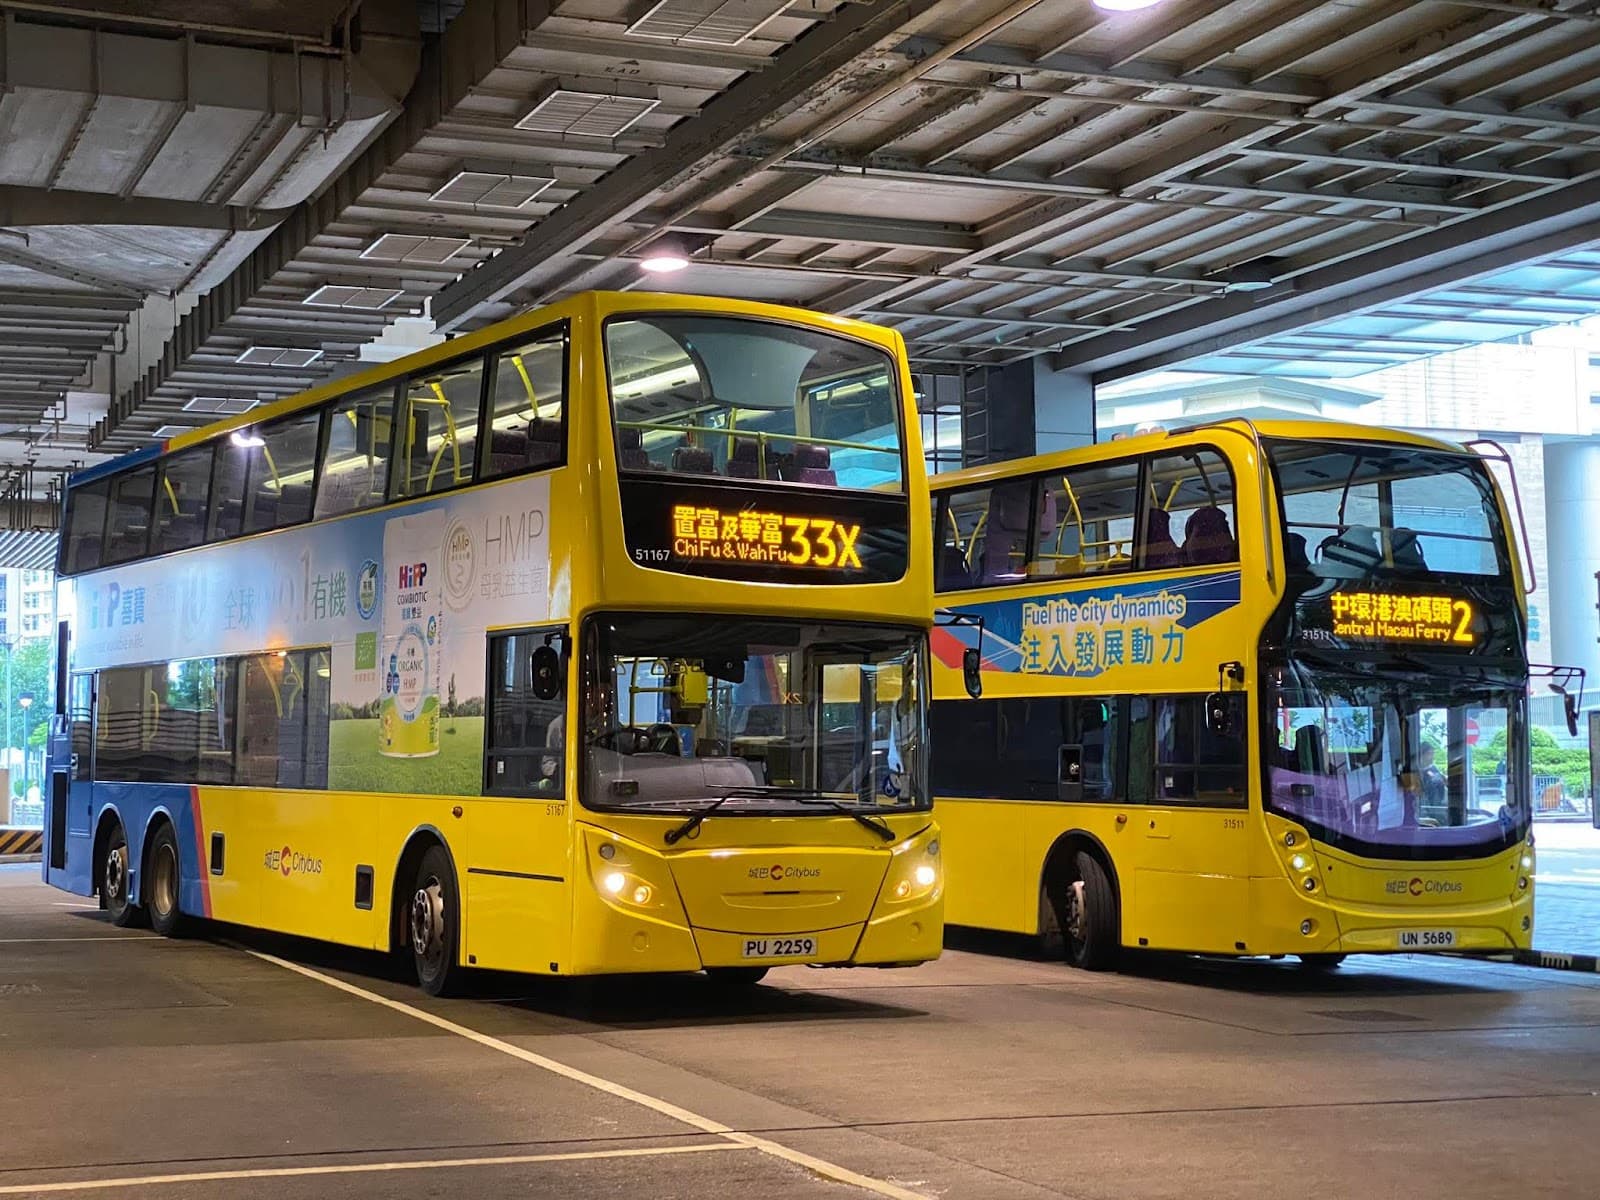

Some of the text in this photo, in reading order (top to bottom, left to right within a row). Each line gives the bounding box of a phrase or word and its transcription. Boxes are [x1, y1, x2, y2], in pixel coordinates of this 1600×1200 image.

[673, 506, 782, 544] 置富及華富
[485, 509, 544, 566] HMP
[785, 517, 862, 569] 33X
[635, 549, 670, 561] 51167
[674, 539, 698, 557] Chi
[700, 540, 720, 558] Fu
[722, 542, 737, 559] &
[399, 562, 427, 590] HiPP
[311, 570, 347, 621] 有機
[1024, 596, 1185, 625] Fuel the city dynamics
[1330, 591, 1452, 623] 中環港澳碼頭
[1377, 621, 1414, 638] Macau
[1416, 623, 1451, 642] Ferry
[1452, 600, 1473, 642] 2
[1023, 625, 1185, 670] 注入發展動力
[546, 804, 566, 816] 51167
[1223, 818, 1245, 829] 31511
[292, 852, 322, 874] Citybus
[784, 866, 820, 879] Citybus
[1424, 880, 1463, 894] Citybus
[746, 939, 813, 955] PU 2259
[1402, 931, 1453, 945] UN 5689
